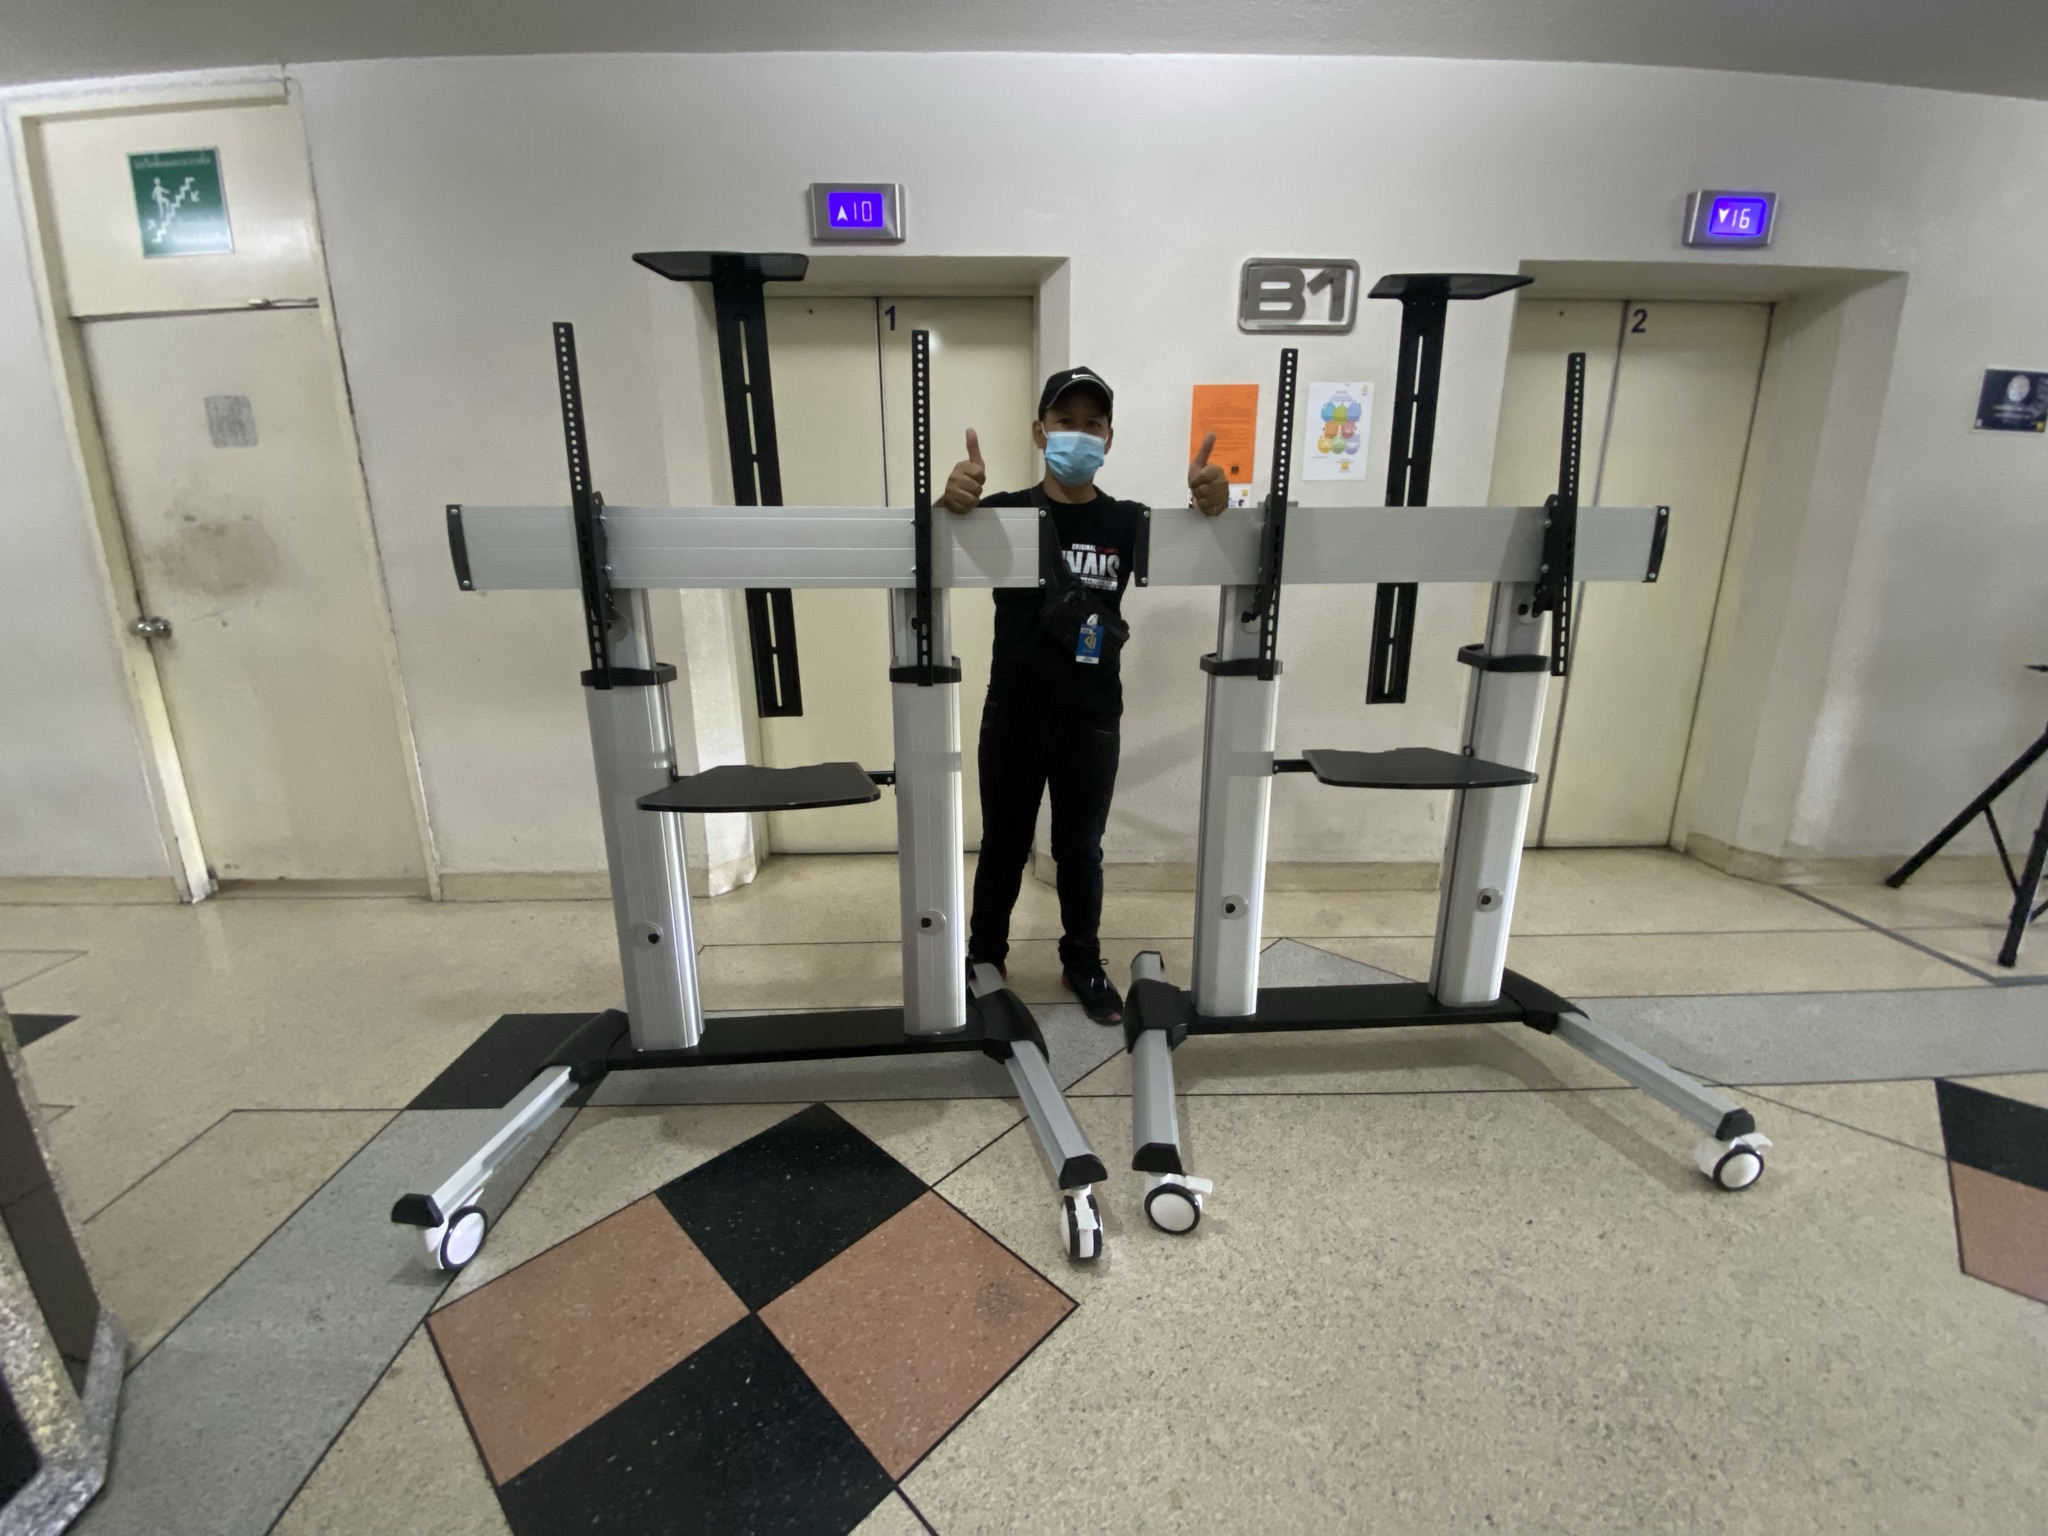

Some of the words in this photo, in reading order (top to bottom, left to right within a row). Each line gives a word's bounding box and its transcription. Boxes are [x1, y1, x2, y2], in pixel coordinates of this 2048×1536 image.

[853, 200, 873, 222] 10
[1731, 208, 1751, 229] 16
[1244, 266, 1347, 323] B1
[884, 305, 896, 331] 1
[1631, 308, 1648, 333] 2
